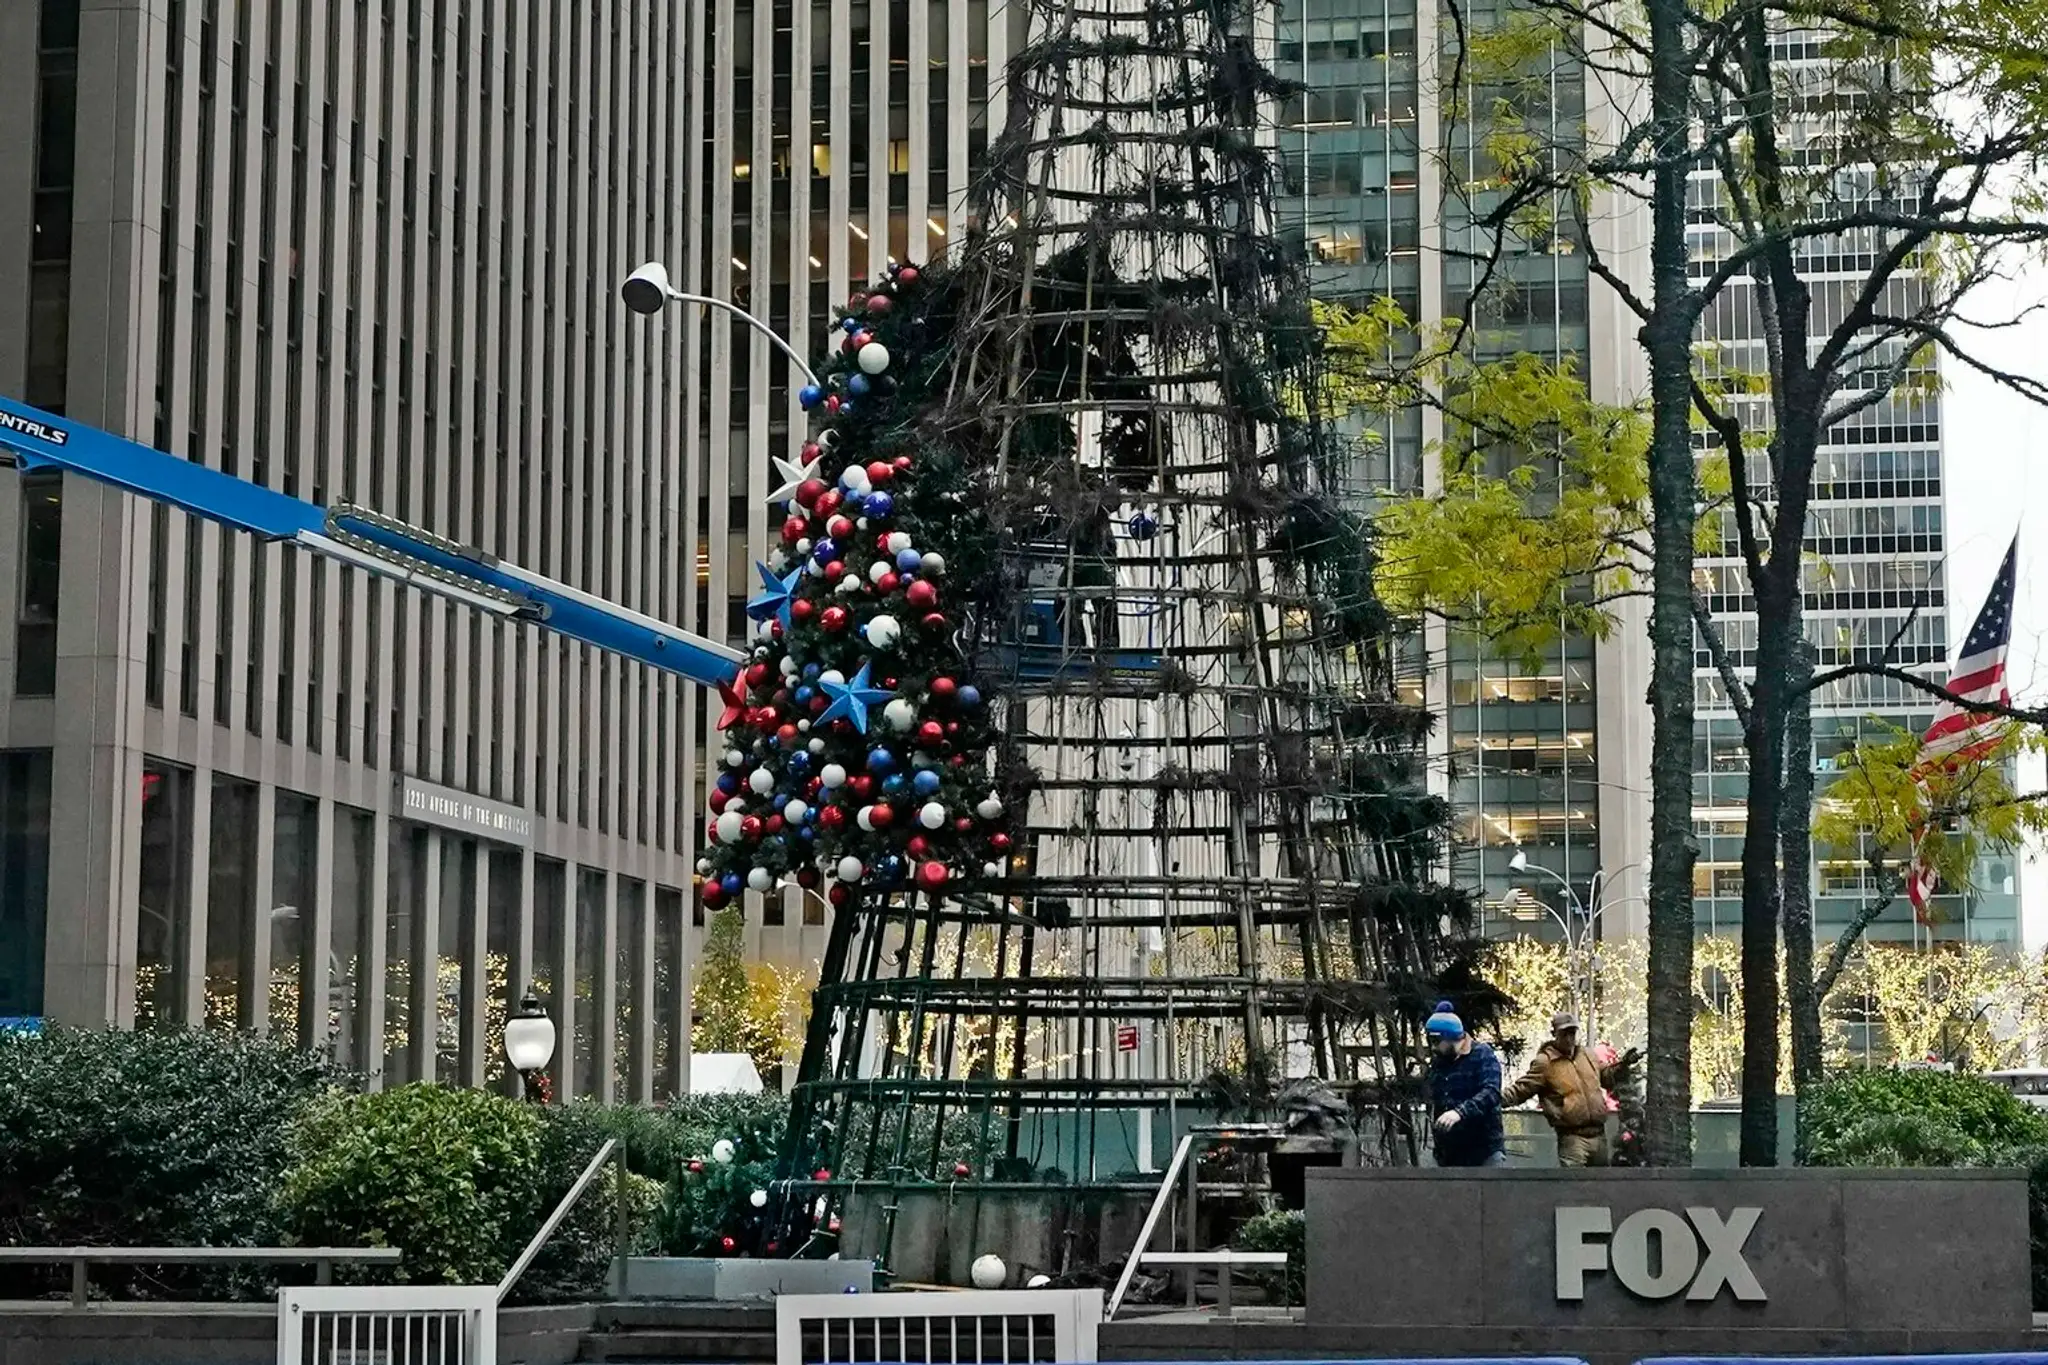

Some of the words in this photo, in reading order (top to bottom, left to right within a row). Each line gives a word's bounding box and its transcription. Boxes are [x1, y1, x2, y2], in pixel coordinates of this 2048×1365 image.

[0, 412, 66, 444] NTALS
[406, 789, 425, 809] 1221
[430, 795, 459, 818] AVENUE
[463, 804, 473, 821] OF
[476, 807, 490, 826] THE
[494, 812, 529, 836] AMERICAS
[1555, 1207, 1768, 1301] FOX
